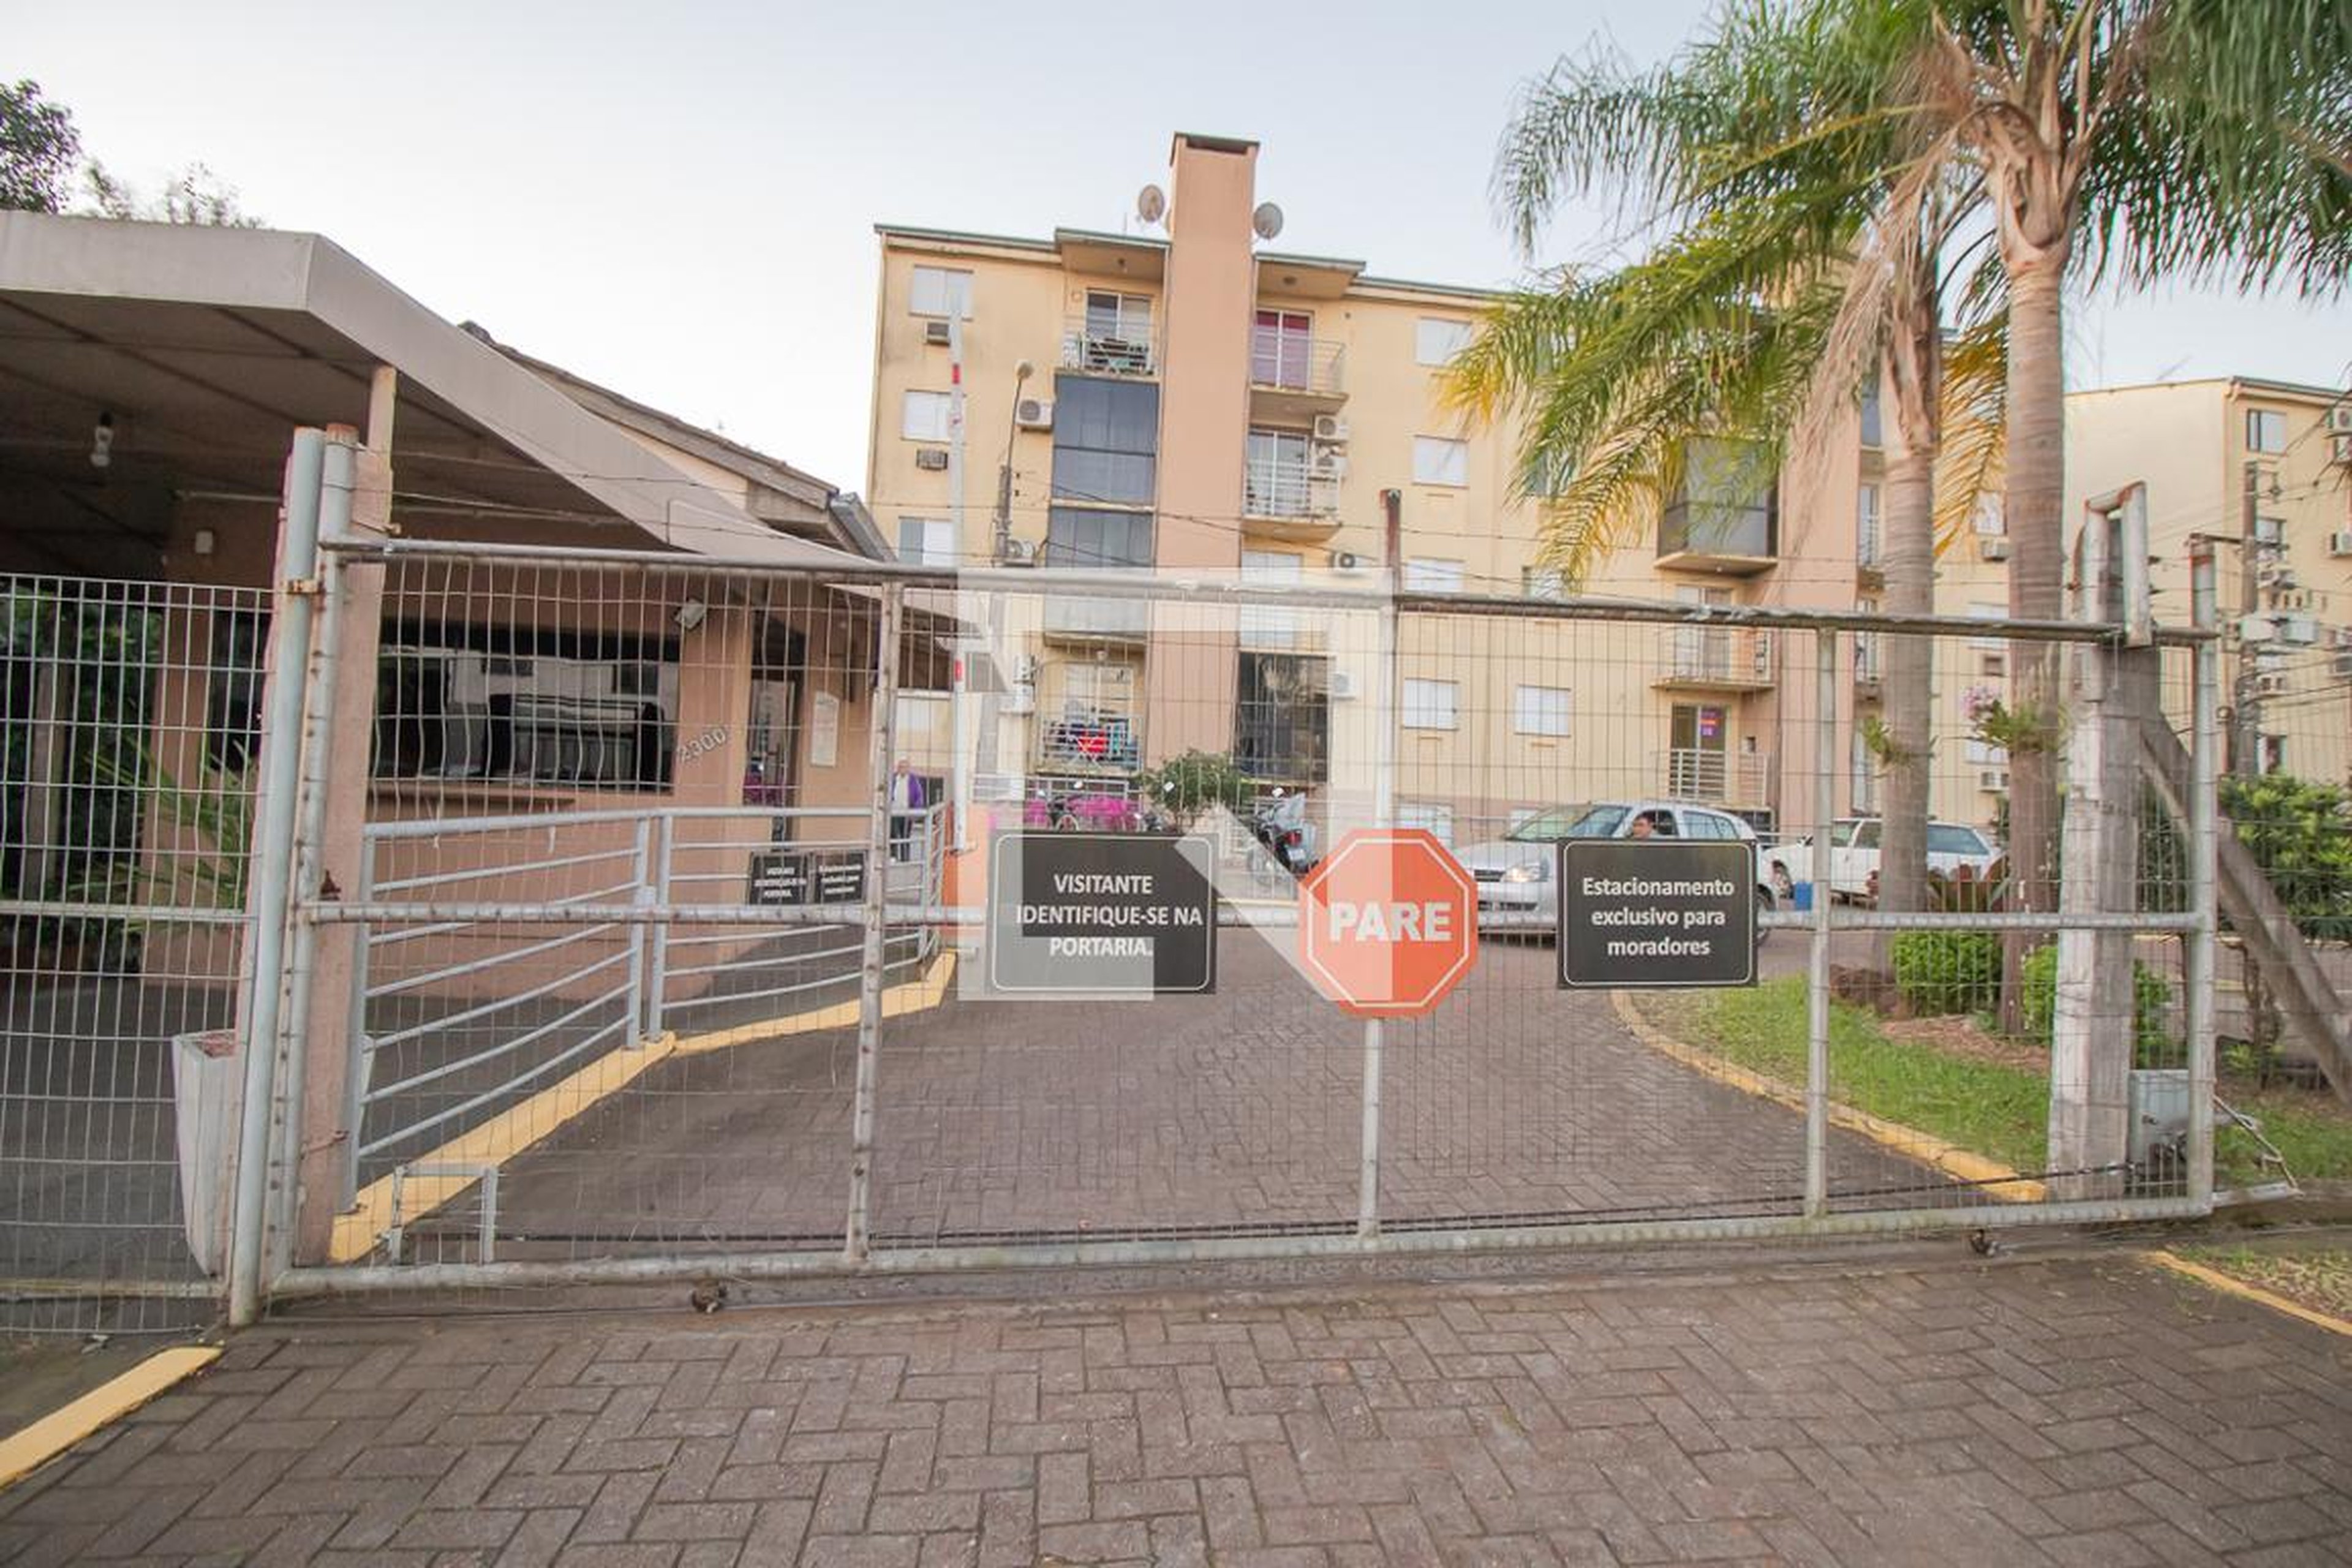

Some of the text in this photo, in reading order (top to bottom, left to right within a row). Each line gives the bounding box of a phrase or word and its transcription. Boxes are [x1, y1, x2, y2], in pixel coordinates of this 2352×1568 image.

[1054, 874, 1153, 894] VISITANTE
[1583, 877, 1735, 895] Estacionamento
[1016, 905, 1204, 927] IDENTIFIQUE-SE NA
[1330, 901, 1452, 942] PARE
[1591, 907, 1725, 929] exclusivo para
[1050, 937, 1153, 956] PORTARIA.
[1607, 937, 1711, 956] moradores
